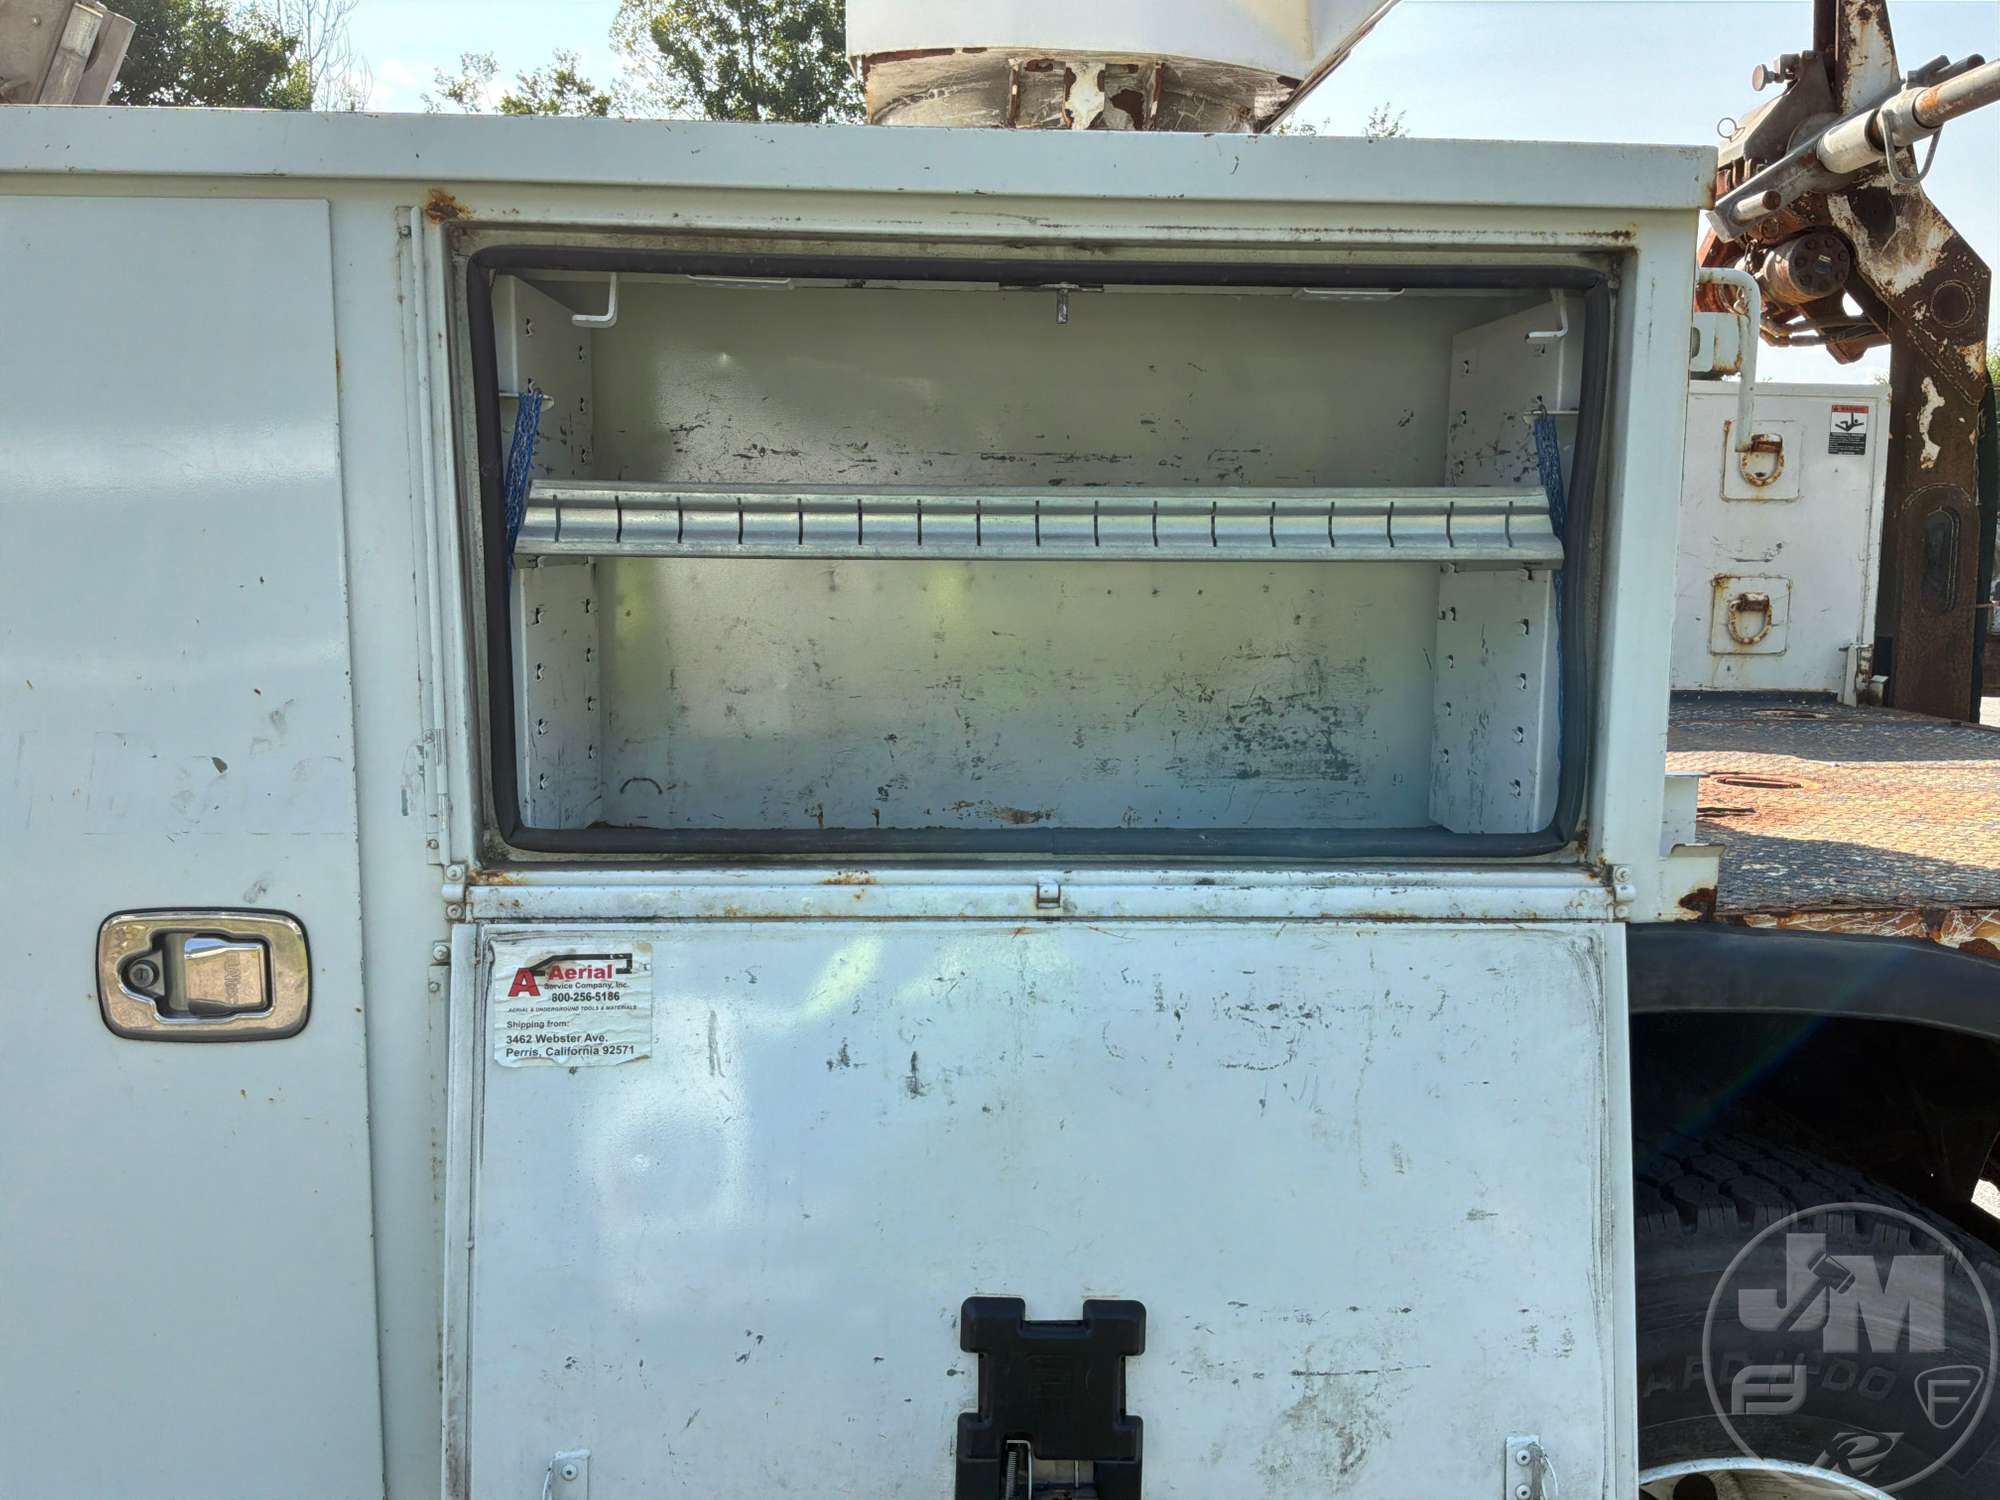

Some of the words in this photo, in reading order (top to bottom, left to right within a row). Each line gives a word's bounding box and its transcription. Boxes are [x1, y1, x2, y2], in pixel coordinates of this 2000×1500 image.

[548, 964, 613, 980] Aerial
[575, 982, 614, 990] Company,
[551, 991, 620, 1002] 800-256-5186
[506, 1020, 545, 1030] Shipping
[547, 1020, 570, 1028] from:
[506, 1034, 534, 1044] 3462
[536, 1033, 581, 1043] Webster
[584, 1033, 608, 1043] Ave.
[506, 1047, 542, 1058] Perris,
[545, 1046, 600, 1056] California
[603, 1045, 635, 1055] 92571
